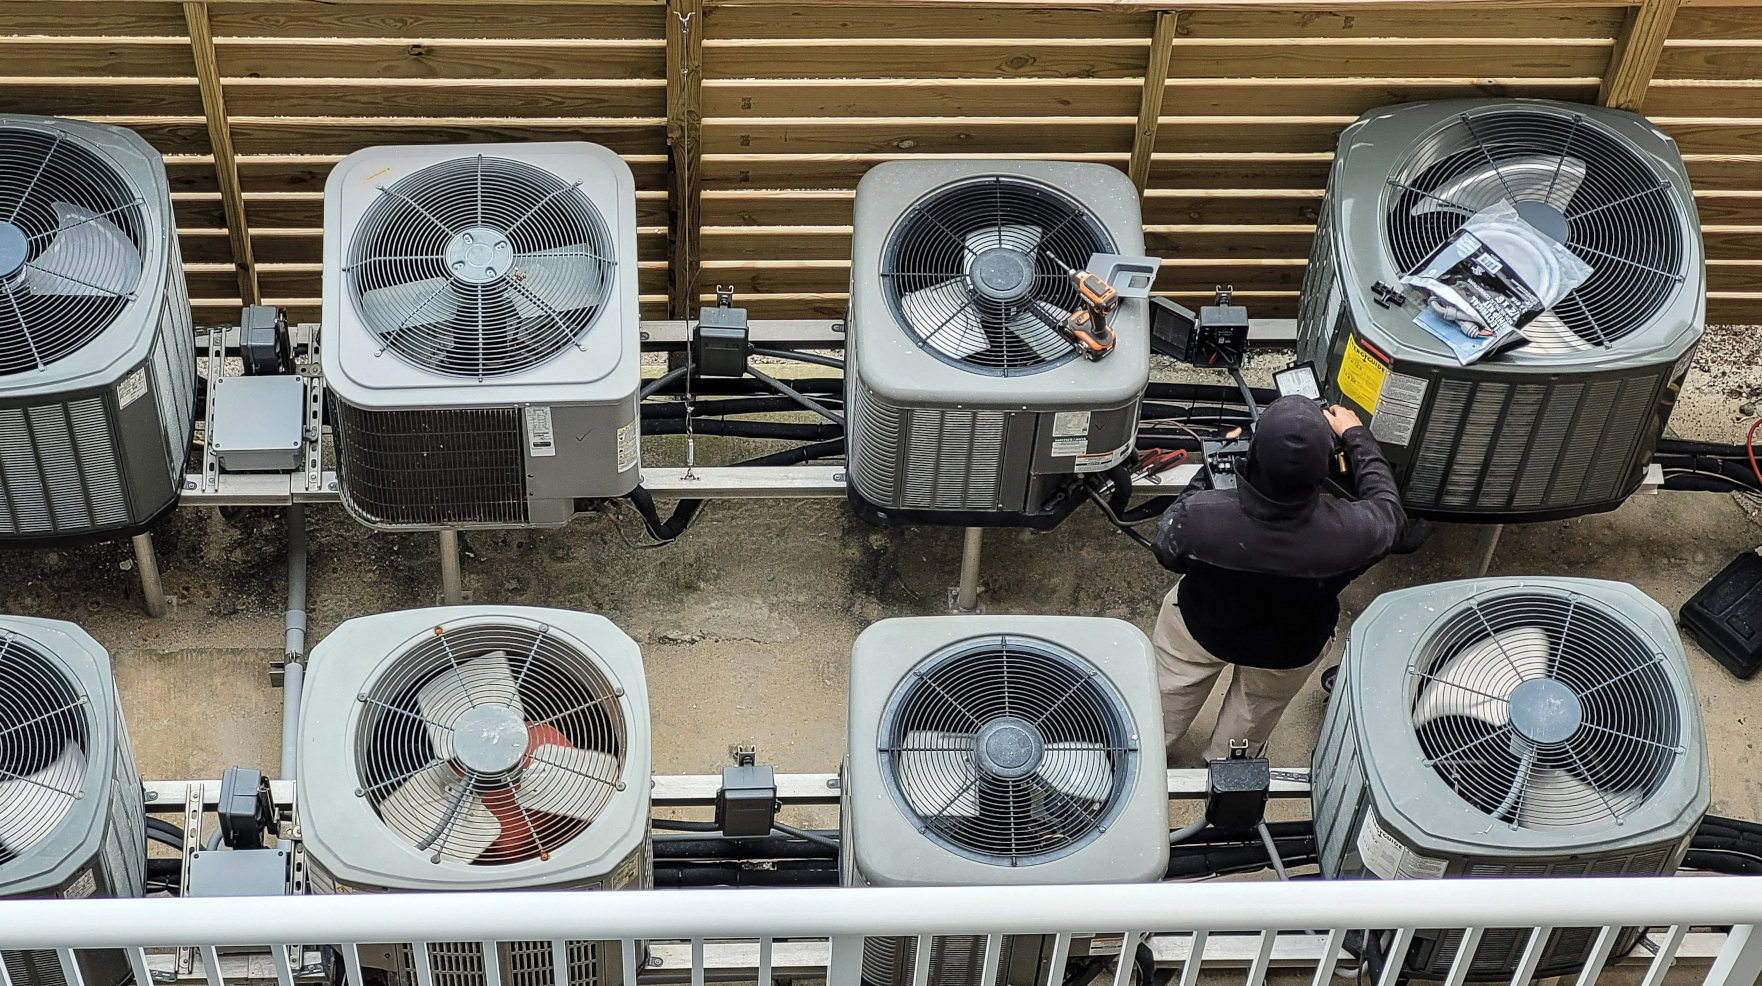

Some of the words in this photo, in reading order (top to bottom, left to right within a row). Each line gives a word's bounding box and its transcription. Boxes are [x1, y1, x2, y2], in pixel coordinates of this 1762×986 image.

[1467, 278, 1490, 299] CONNECTORS
[1469, 295, 1501, 333] ELECTRICAL
[1482, 300, 1495, 312] KIT
